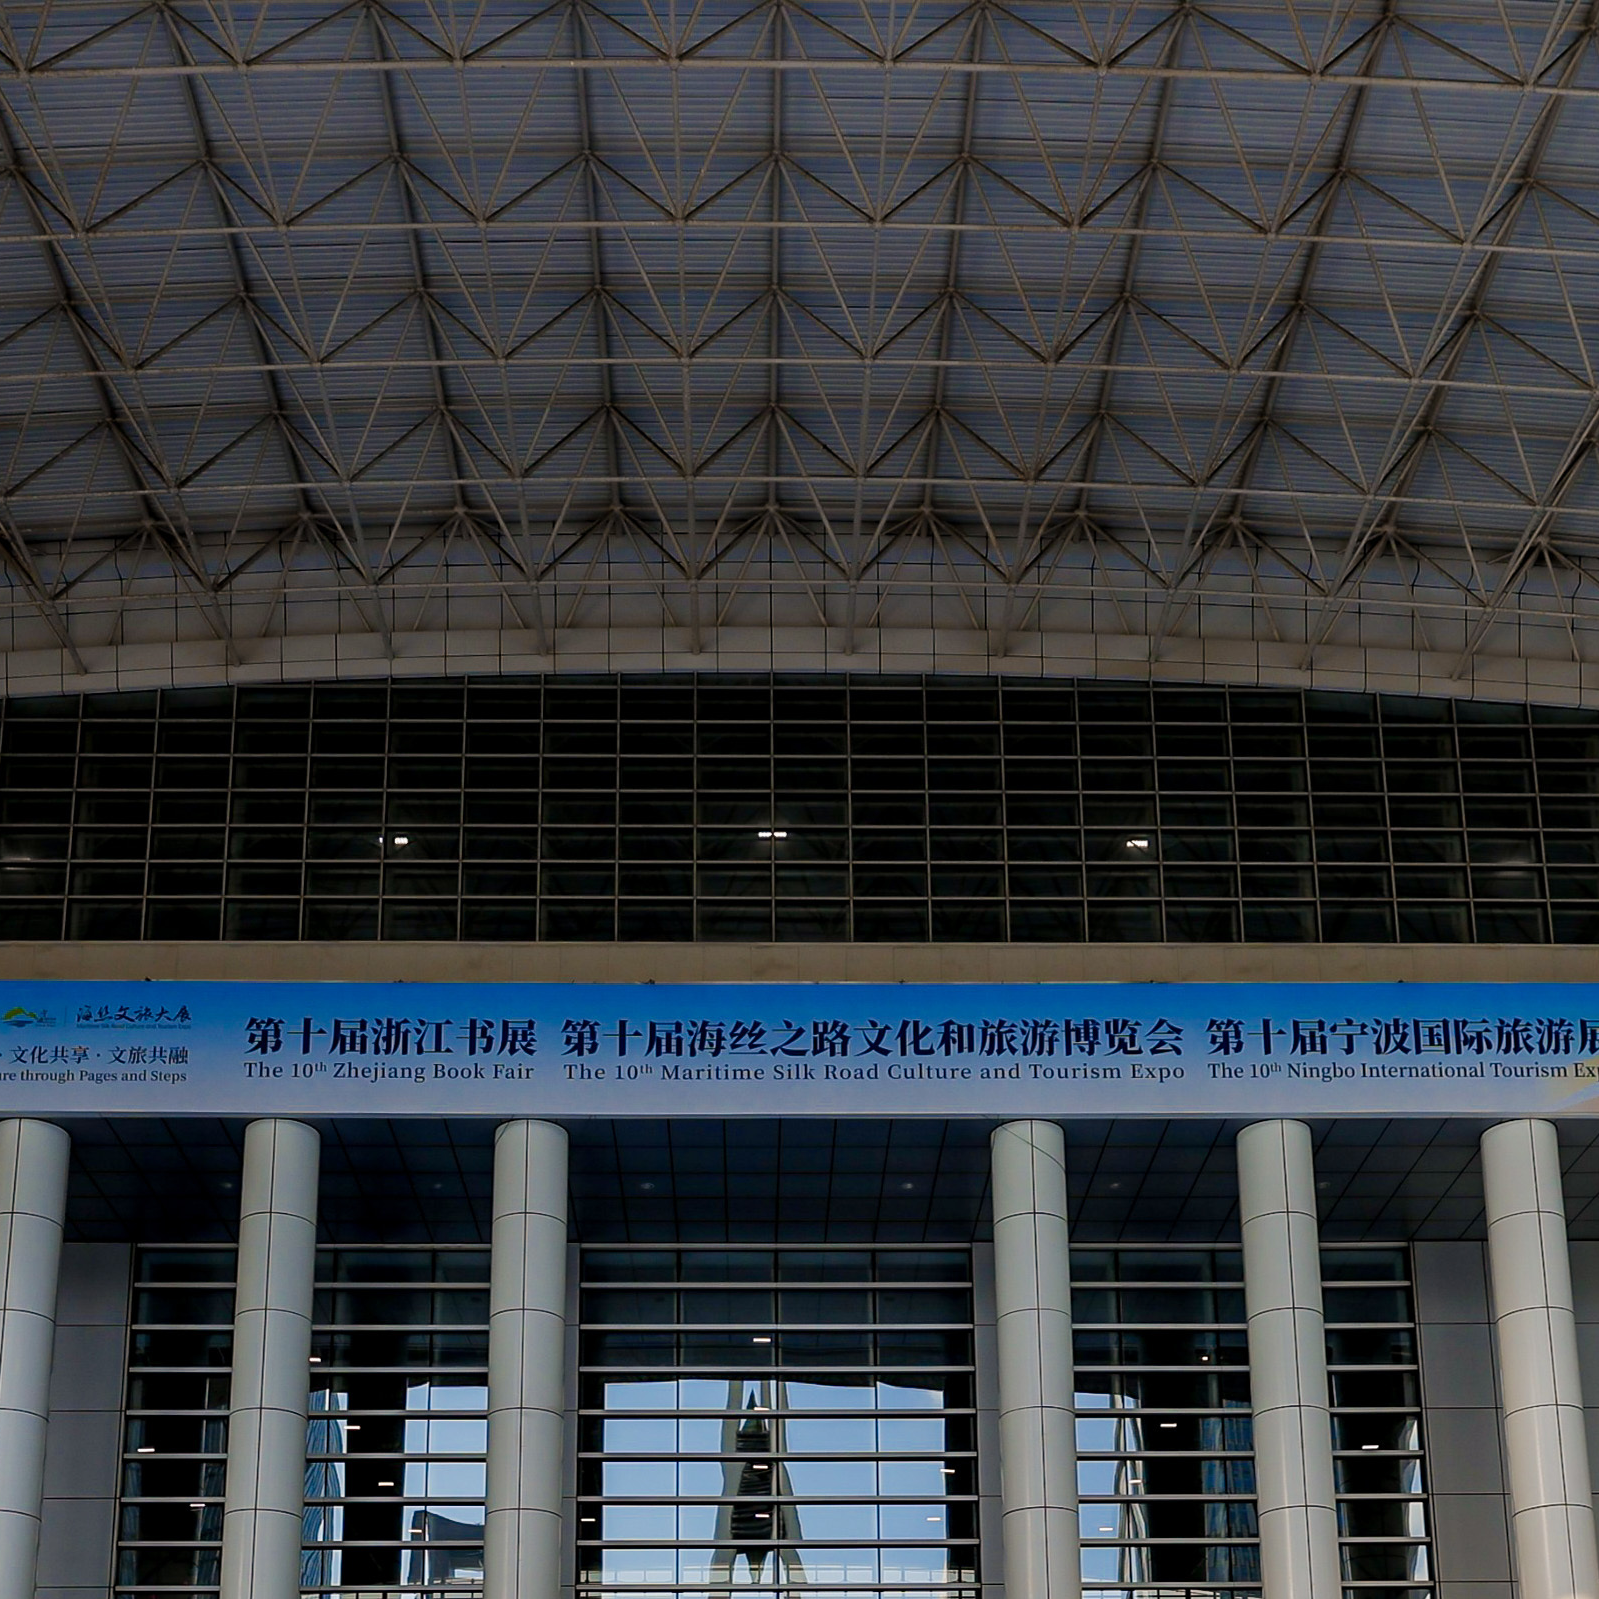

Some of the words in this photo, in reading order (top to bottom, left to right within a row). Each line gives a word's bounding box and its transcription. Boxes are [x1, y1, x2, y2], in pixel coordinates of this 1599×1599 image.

[246, 1016, 538, 1056] 第十届浙江书展
[561, 1018, 1185, 1057] 第十届海丝之路文化和旅游博览会
[20, 1069, 74, 1085] through
[79, 1070, 117, 1085] Pages
[121, 1069, 147, 1082] and
[151, 1070, 187, 1085] Steps
[244, 1061, 283, 1080] The
[290, 1061, 327, 1080] 10th
[332, 1061, 427, 1084] Zhejiang
[432, 1061, 484, 1080] Book
[491, 1061, 534, 1080] Fair
[564, 1062, 605, 1080] The
[614, 1062, 653, 1080] 10th
[661, 1062, 765, 1080] Maritime
[772, 1062, 816, 1080] Silk
[823, 1062, 879, 1080] Road
[888, 1062, 971, 1080] Culture
[980, 1062, 1020, 1080] and
[1028, 1062, 1121, 1080] Tourism
[1130, 1063, 1185, 1083] Expo
[1208, 1062, 1244, 1079] The
[1249, 1062, 1282, 1079] 10th
[1286, 1062, 1356, 1082] Ningbo
[1360, 1062, 1485, 1079] International
[1490, 1062, 1568, 1079] Tourism
